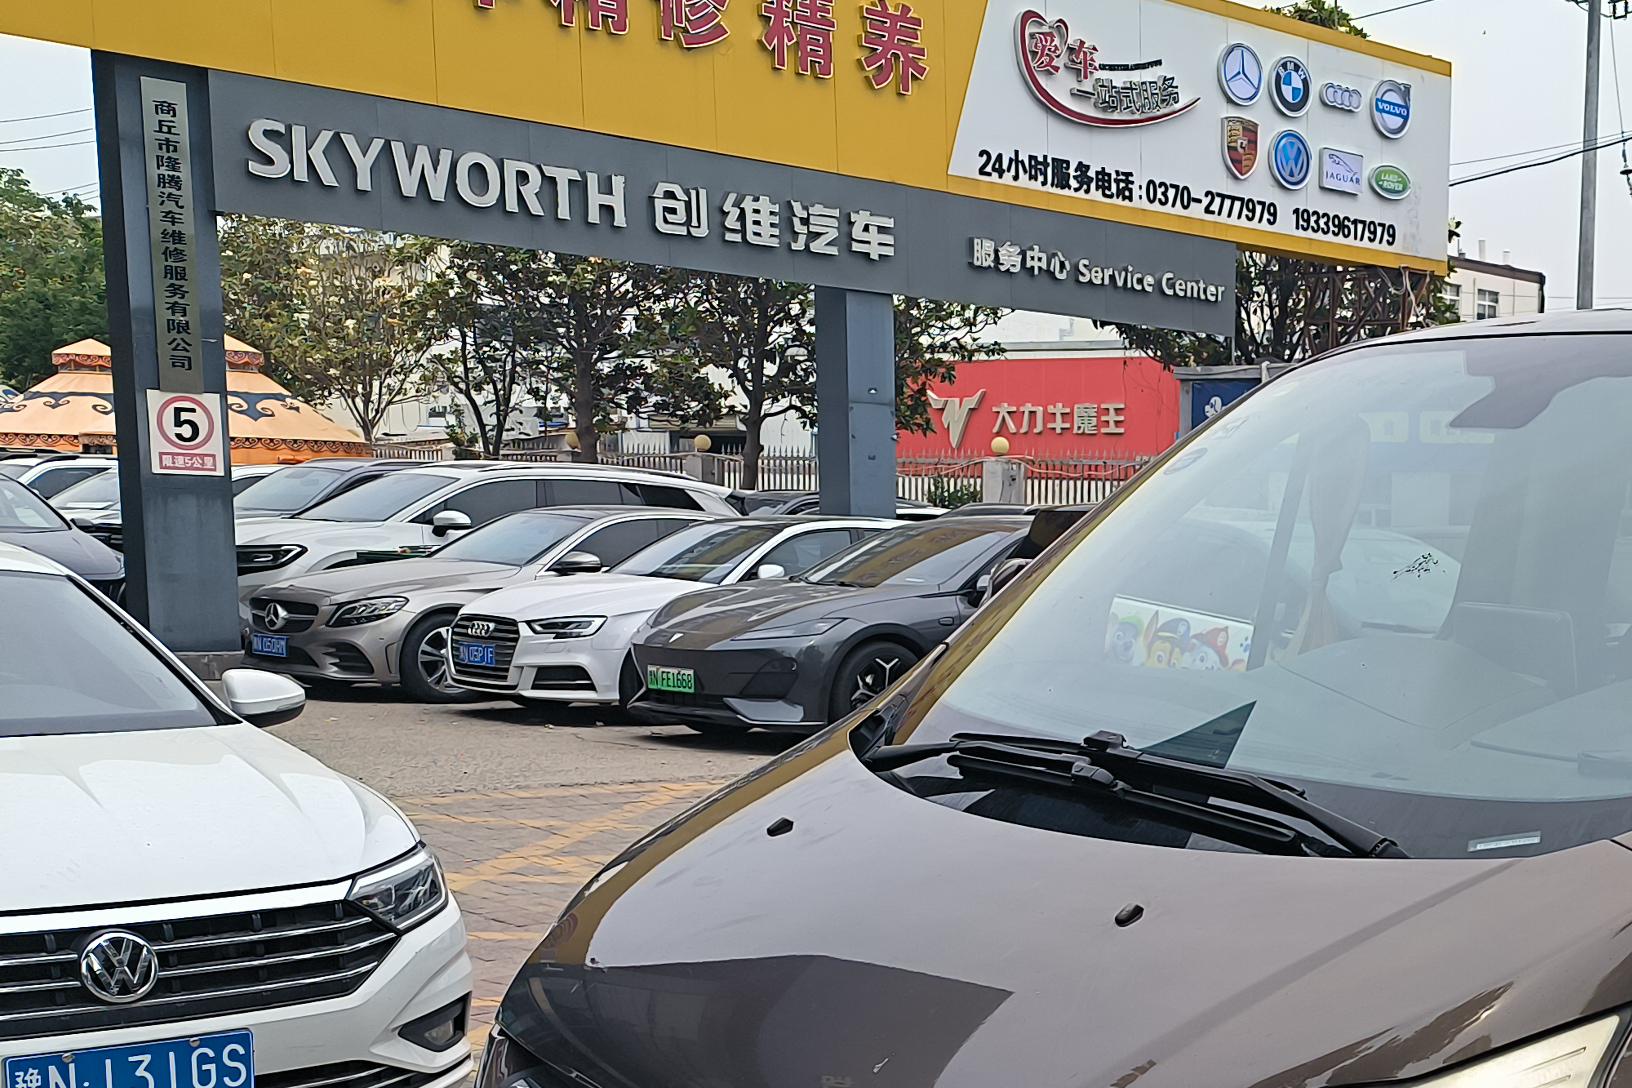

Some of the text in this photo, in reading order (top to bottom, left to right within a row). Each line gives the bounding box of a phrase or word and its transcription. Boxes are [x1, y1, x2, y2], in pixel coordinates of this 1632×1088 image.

[473, 0, 928, 95] 修精养
[1032, 31, 1100, 80] 爱车
[1277, 61, 1307, 79] BMW
[1073, 76, 1181, 113] 一站式服务
[1377, 101, 1408, 116] VOLVO
[247, 118, 897, 261] SKYWORTH 创维汽车
[1325, 170, 1361, 186] JAGUAR
[152, 99, 193, 371] 商丘市隆腾汽车维修服务有限公司
[1292, 207, 1397, 247] 19339617979
[971, 237, 1226, 304] 服务中心 Service Center
[172, 406, 200, 443] 5
[991, 402, 1125, 434] 大力牛魔王
